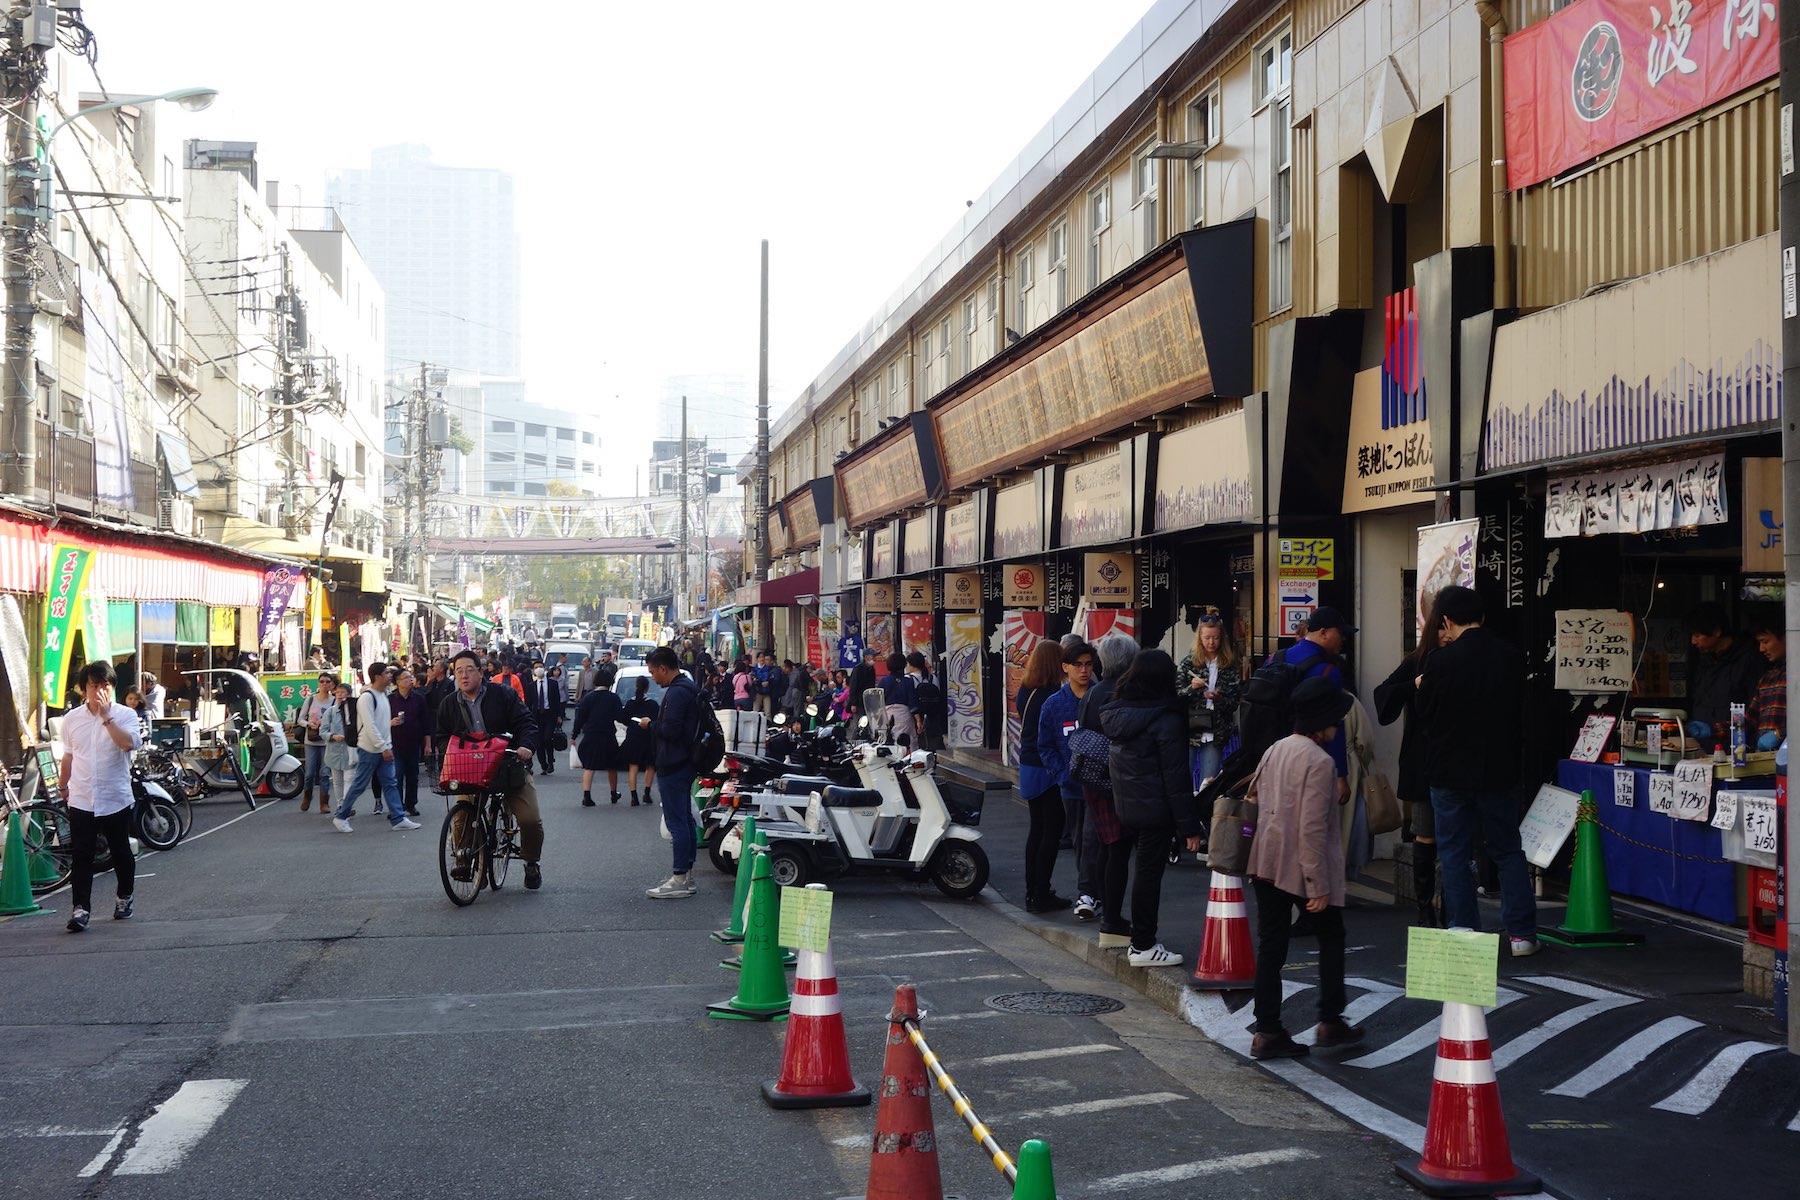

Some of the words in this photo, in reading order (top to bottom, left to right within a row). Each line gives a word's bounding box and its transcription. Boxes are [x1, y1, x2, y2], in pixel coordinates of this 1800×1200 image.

[1358, 432, 1433, 479] 築地にっぽん
[1365, 484, 1387, 498] TSUKIJI
[1388, 479, 1411, 493] NIPPON
[1412, 476, 1428, 490] FISH
[1293, 540, 1331, 553] コイン
[1479, 514, 1505, 580] 長崎
[1760, 533, 1782, 549] JF
[1154, 549, 1170, 590] 静岡
[1281, 553, 1331, 566] ロッカー
[1511, 515, 1524, 607] NAGASAKI
[1048, 562, 1057, 614] HOKKAIDO
[1059, 562, 1074, 609] 北海道
[1560, 617, 1605, 635] さざえ
[1754, 836, 1776, 850] ¥150
